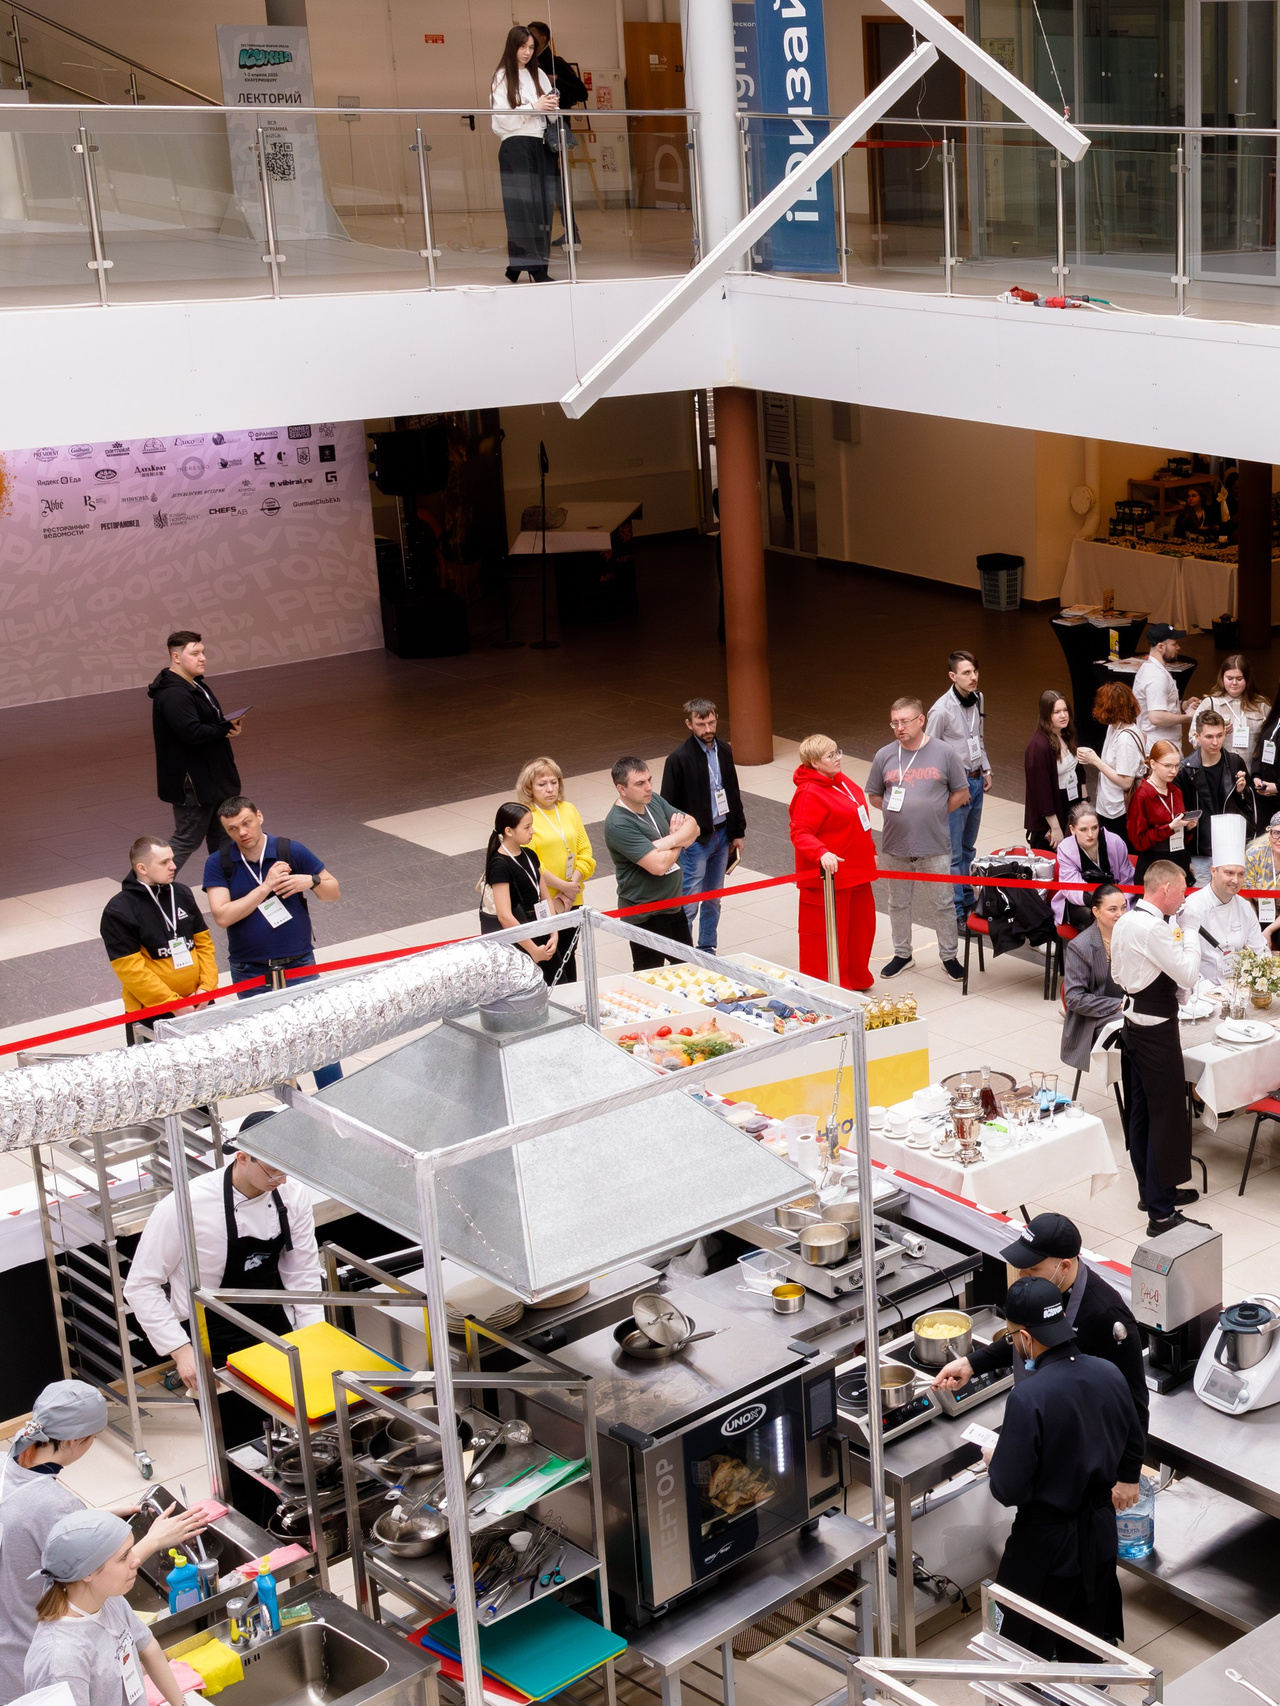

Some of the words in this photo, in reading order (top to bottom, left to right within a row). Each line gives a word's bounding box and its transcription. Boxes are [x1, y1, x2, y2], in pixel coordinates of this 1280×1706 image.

[237, 90, 302, 104] ЛЕКТОРИЙ
[37, 479, 60, 487] Яндекс
[292, 497, 342, 508] GurmetClubEkb
[208, 505, 237, 515] CHEFS
[230, 508, 249, 517] LAB
[100, 520, 140, 530] РЕСТОРАНОВЕД
[86, 541, 236, 613] ФОРУМ
[238, 525, 377, 571] УРАЛ
[157, 938, 195, 958] Reok
[725, 1408, 760, 1433] UNOX
[655, 1457, 681, 1584] CHEFTOP
